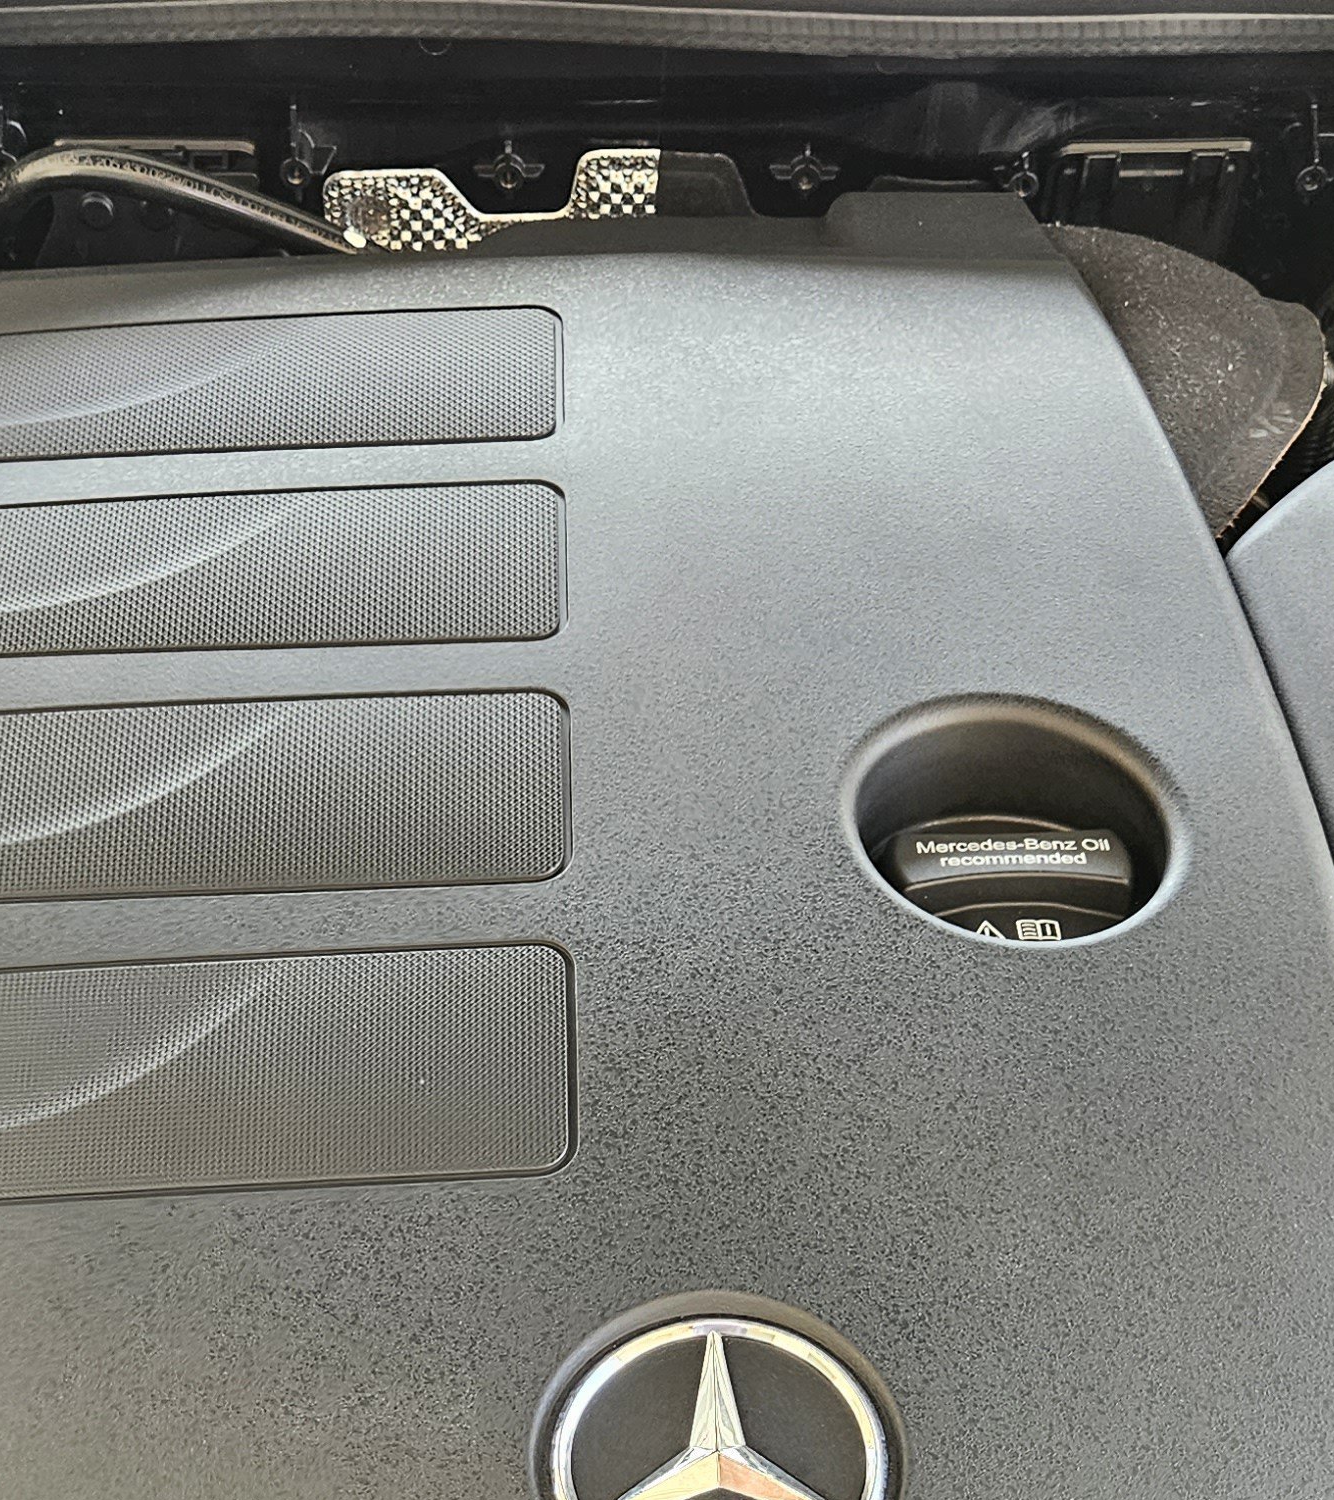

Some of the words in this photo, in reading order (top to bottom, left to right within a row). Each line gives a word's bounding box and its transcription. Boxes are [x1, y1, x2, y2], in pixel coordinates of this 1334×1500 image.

[915, 837, 1078, 855] Mercedes-Benz
[1081, 837, 1111, 852] Oil
[939, 851, 1088, 868] recommended
